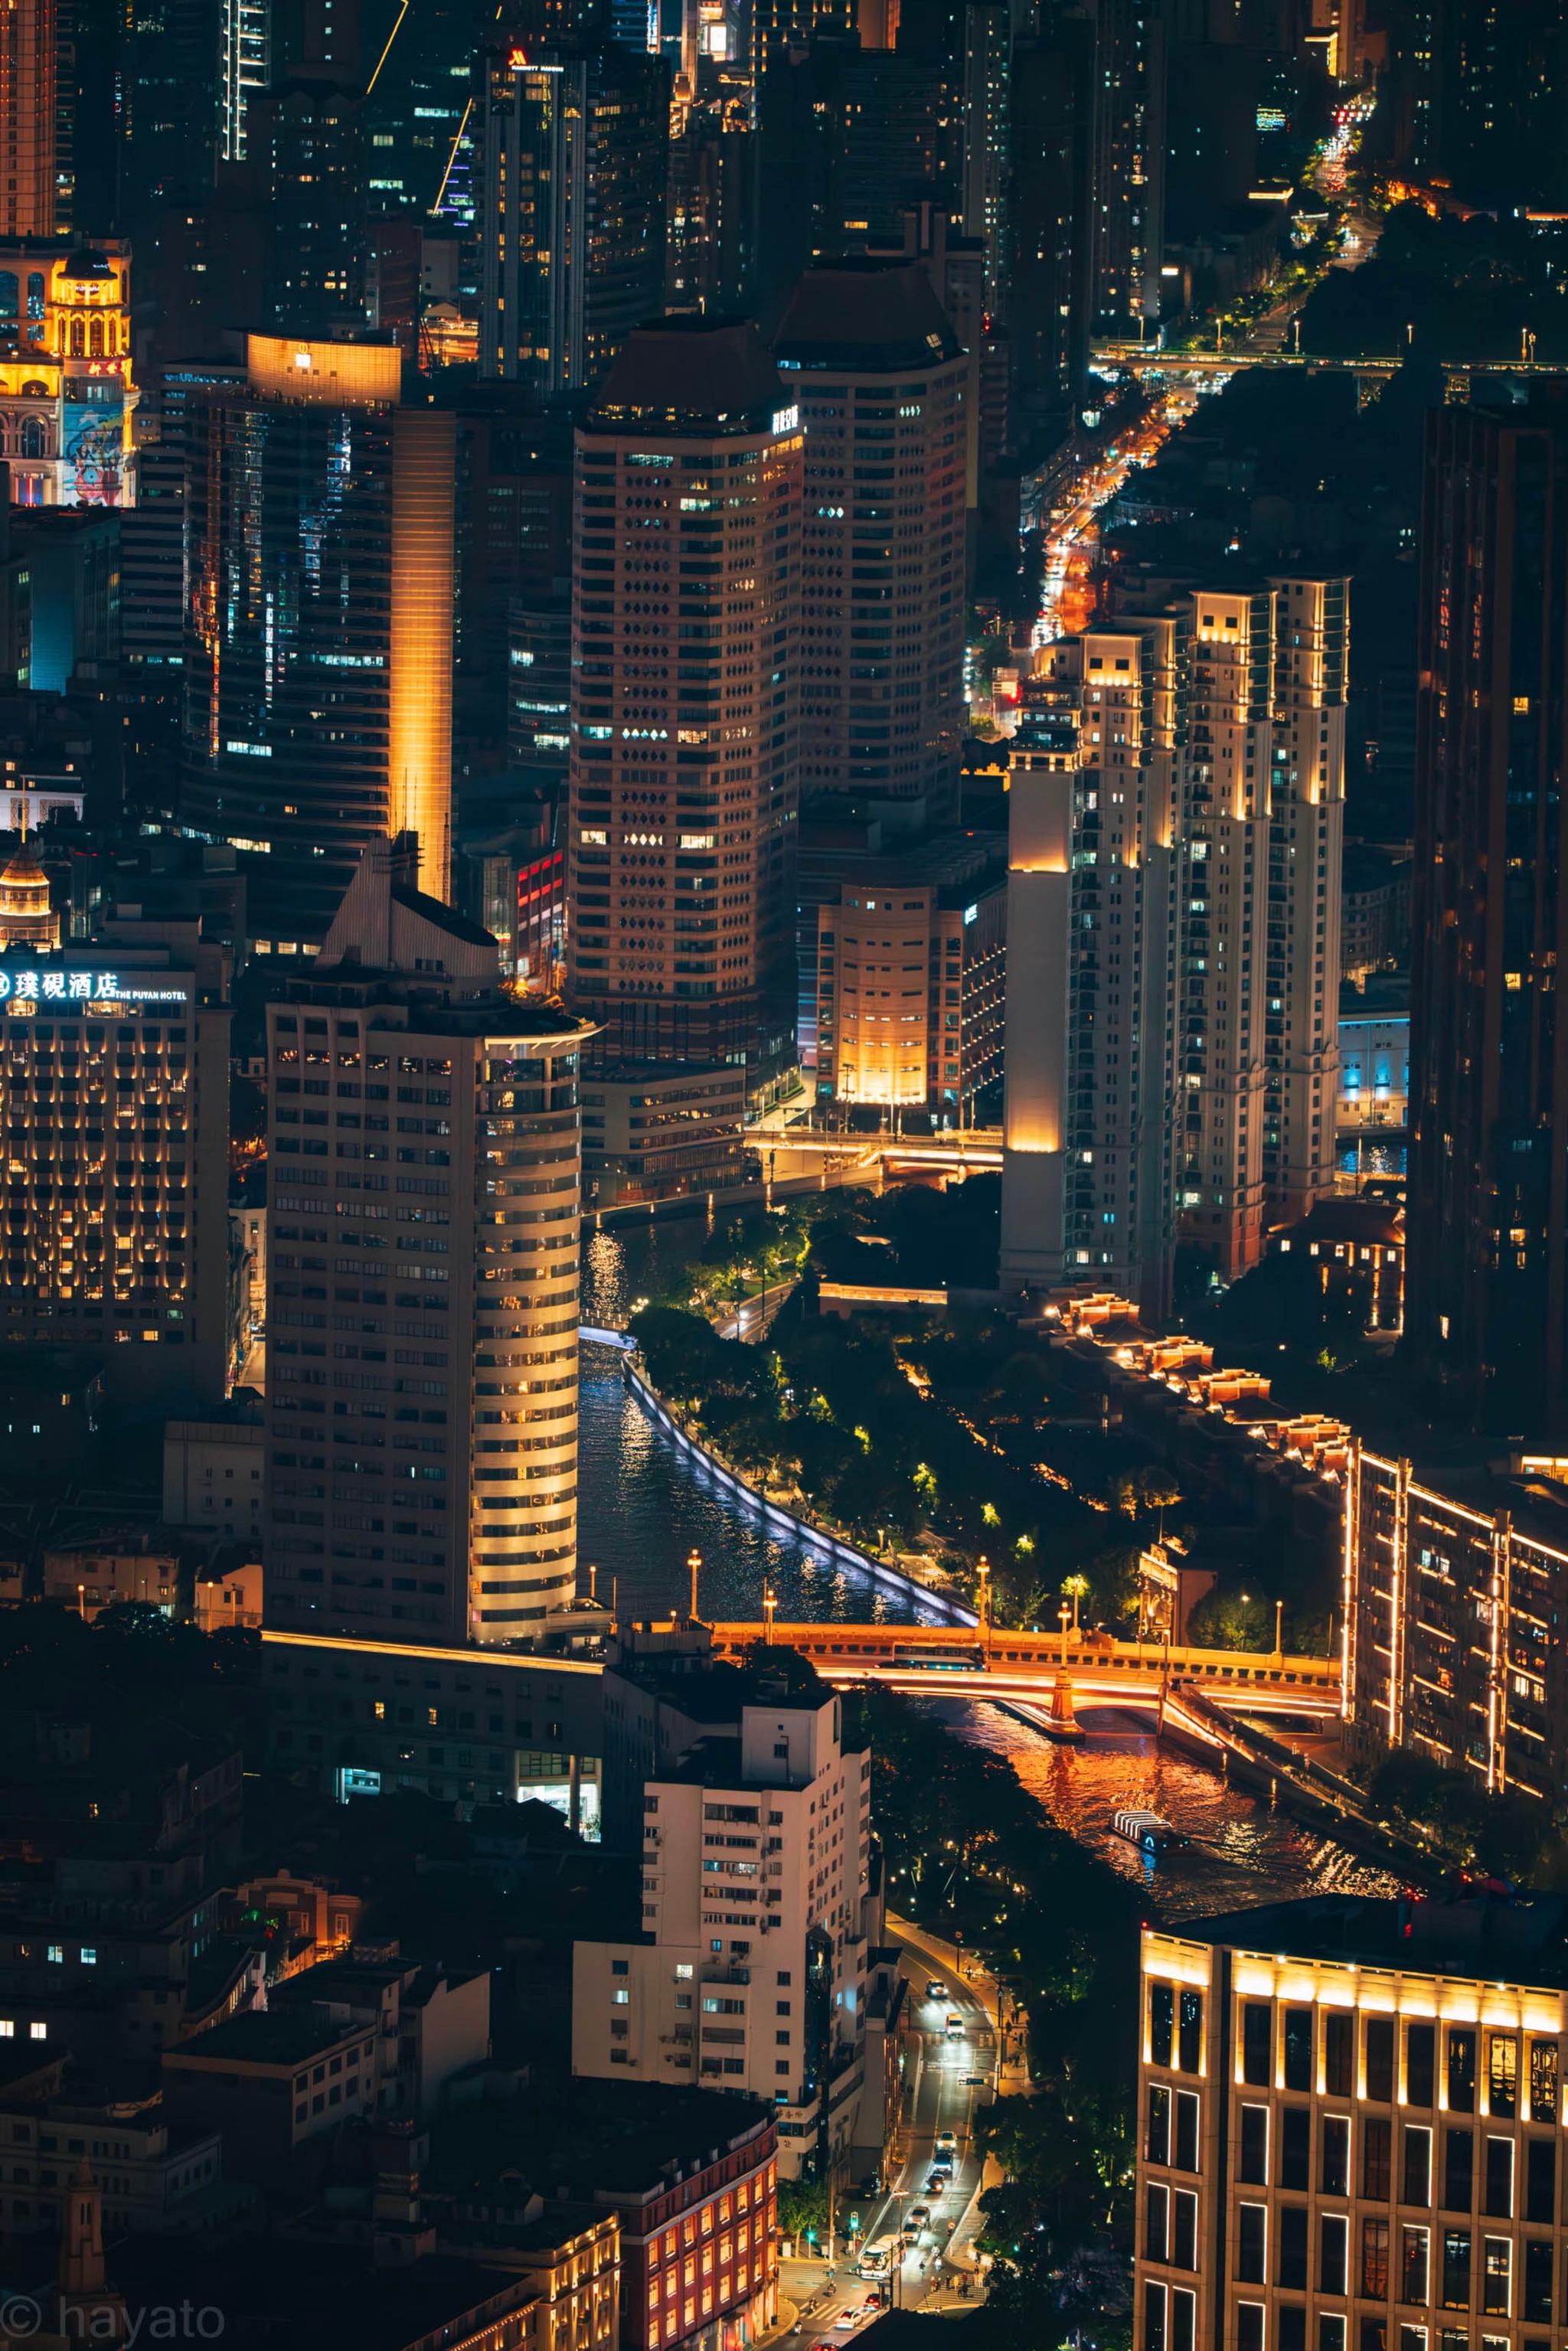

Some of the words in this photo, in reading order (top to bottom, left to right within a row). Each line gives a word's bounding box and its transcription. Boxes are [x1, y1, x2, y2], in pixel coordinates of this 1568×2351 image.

[115, 990, 131, 1000] THE
[132, 990, 158, 1000] PUYAN
[160, 991, 187, 1001] HOTEL
